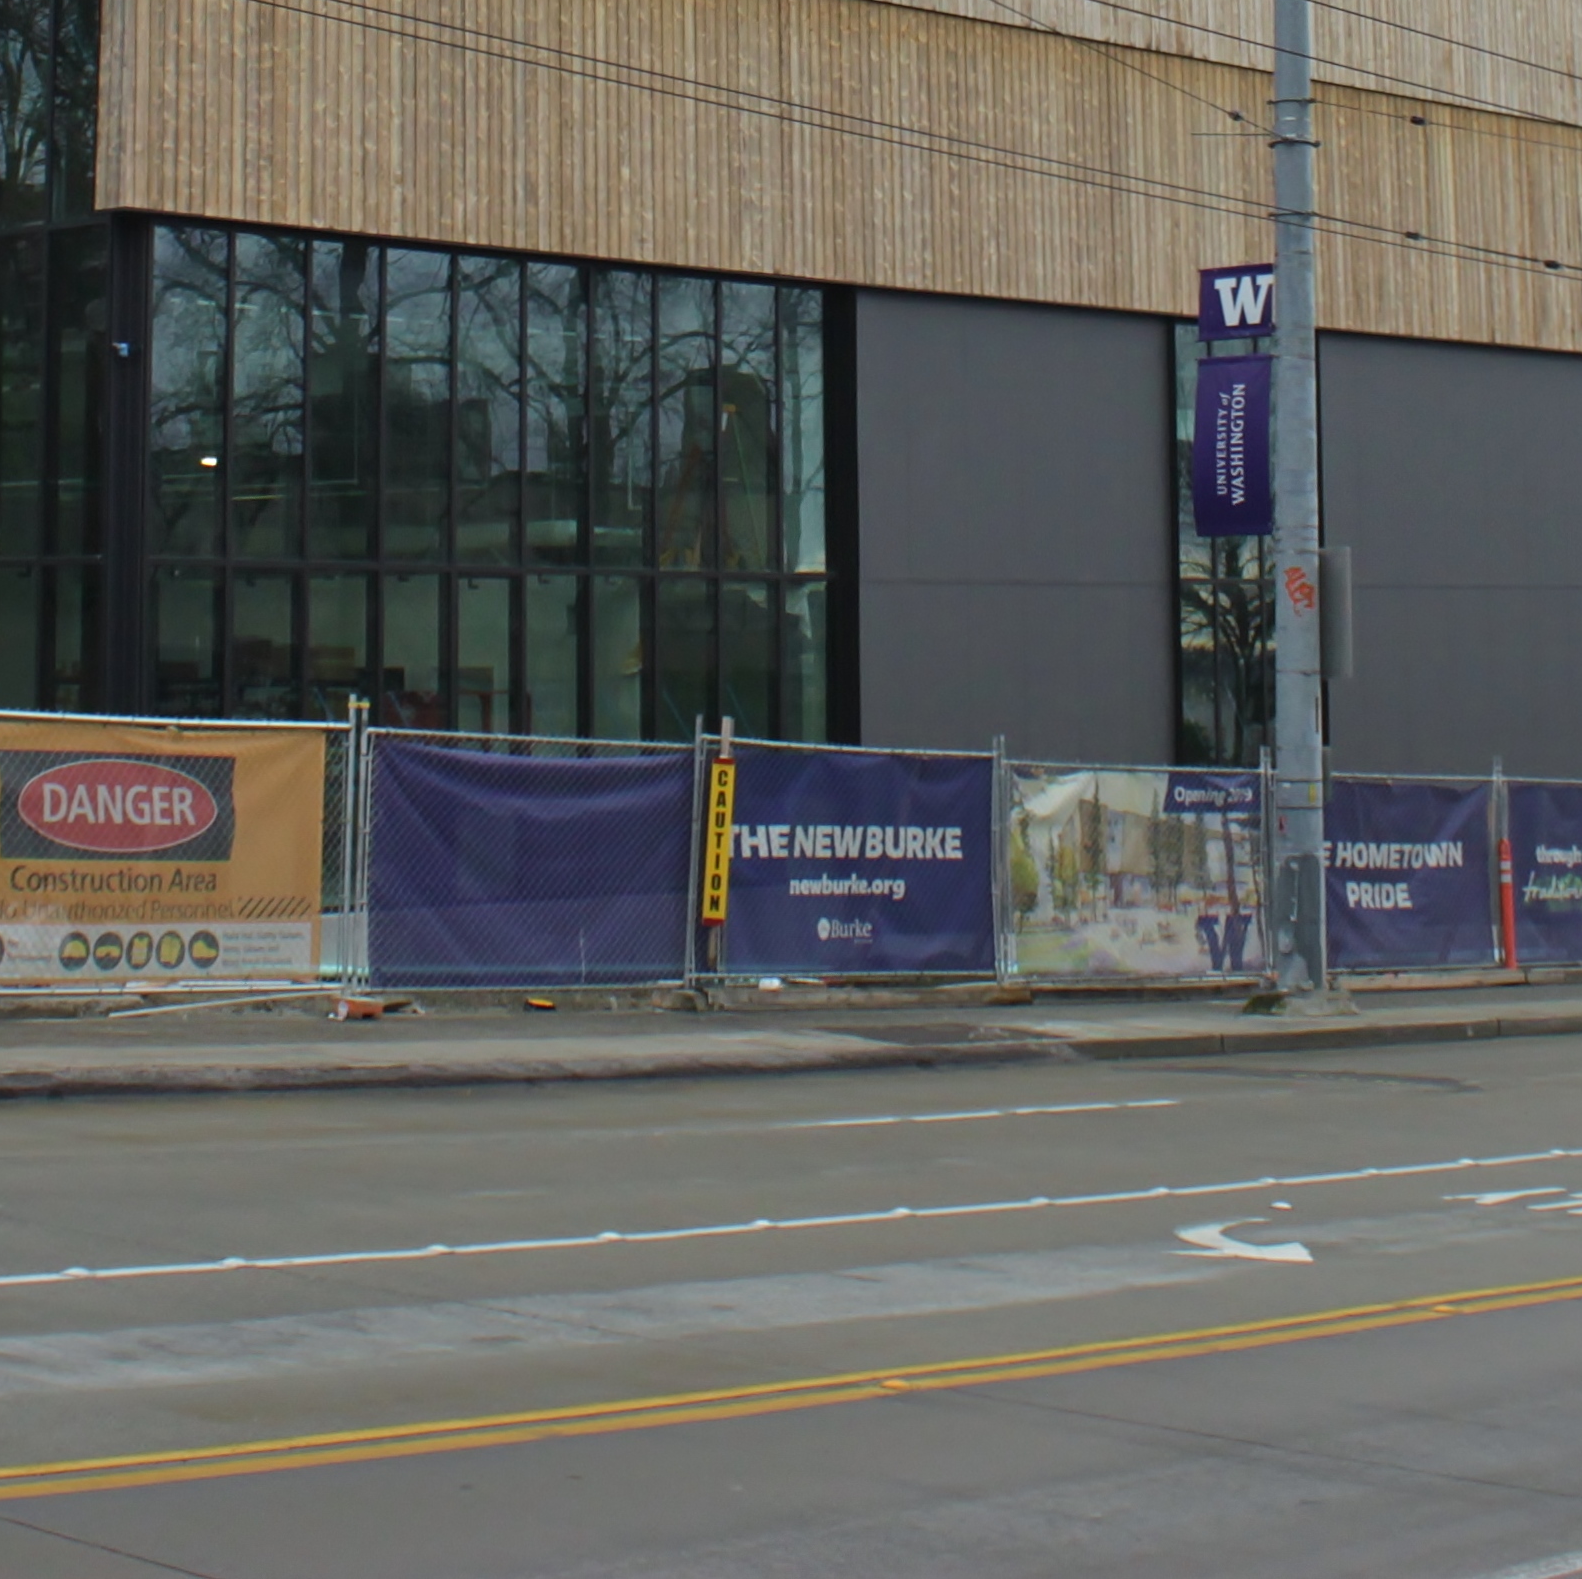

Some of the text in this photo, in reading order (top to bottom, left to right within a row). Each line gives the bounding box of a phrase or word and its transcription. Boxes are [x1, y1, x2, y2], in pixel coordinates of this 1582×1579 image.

[1214, 274, 1274, 327] W
[1216, 392, 1231, 495] UNIVERSITY of
[1230, 384, 1246, 506] WASHINGTON
[42, 782, 197, 826] DANGER
[1174, 786, 1226, 808] Opening
[709, 770, 729, 912] CAUTION
[793, 825, 864, 859] NEW
[865, 825, 963, 860] BURKE
[1335, 841, 1464, 869] HOMETOWN
[10, 864, 218, 893] Construction Area
[789, 873, 907, 900] newburke.org
[23, 898, 147, 921] Unauthorized
[151, 898, 235, 920] Personnel
[1346, 881, 1413, 909] PRIDE
[830, 918, 873, 938] Burke
